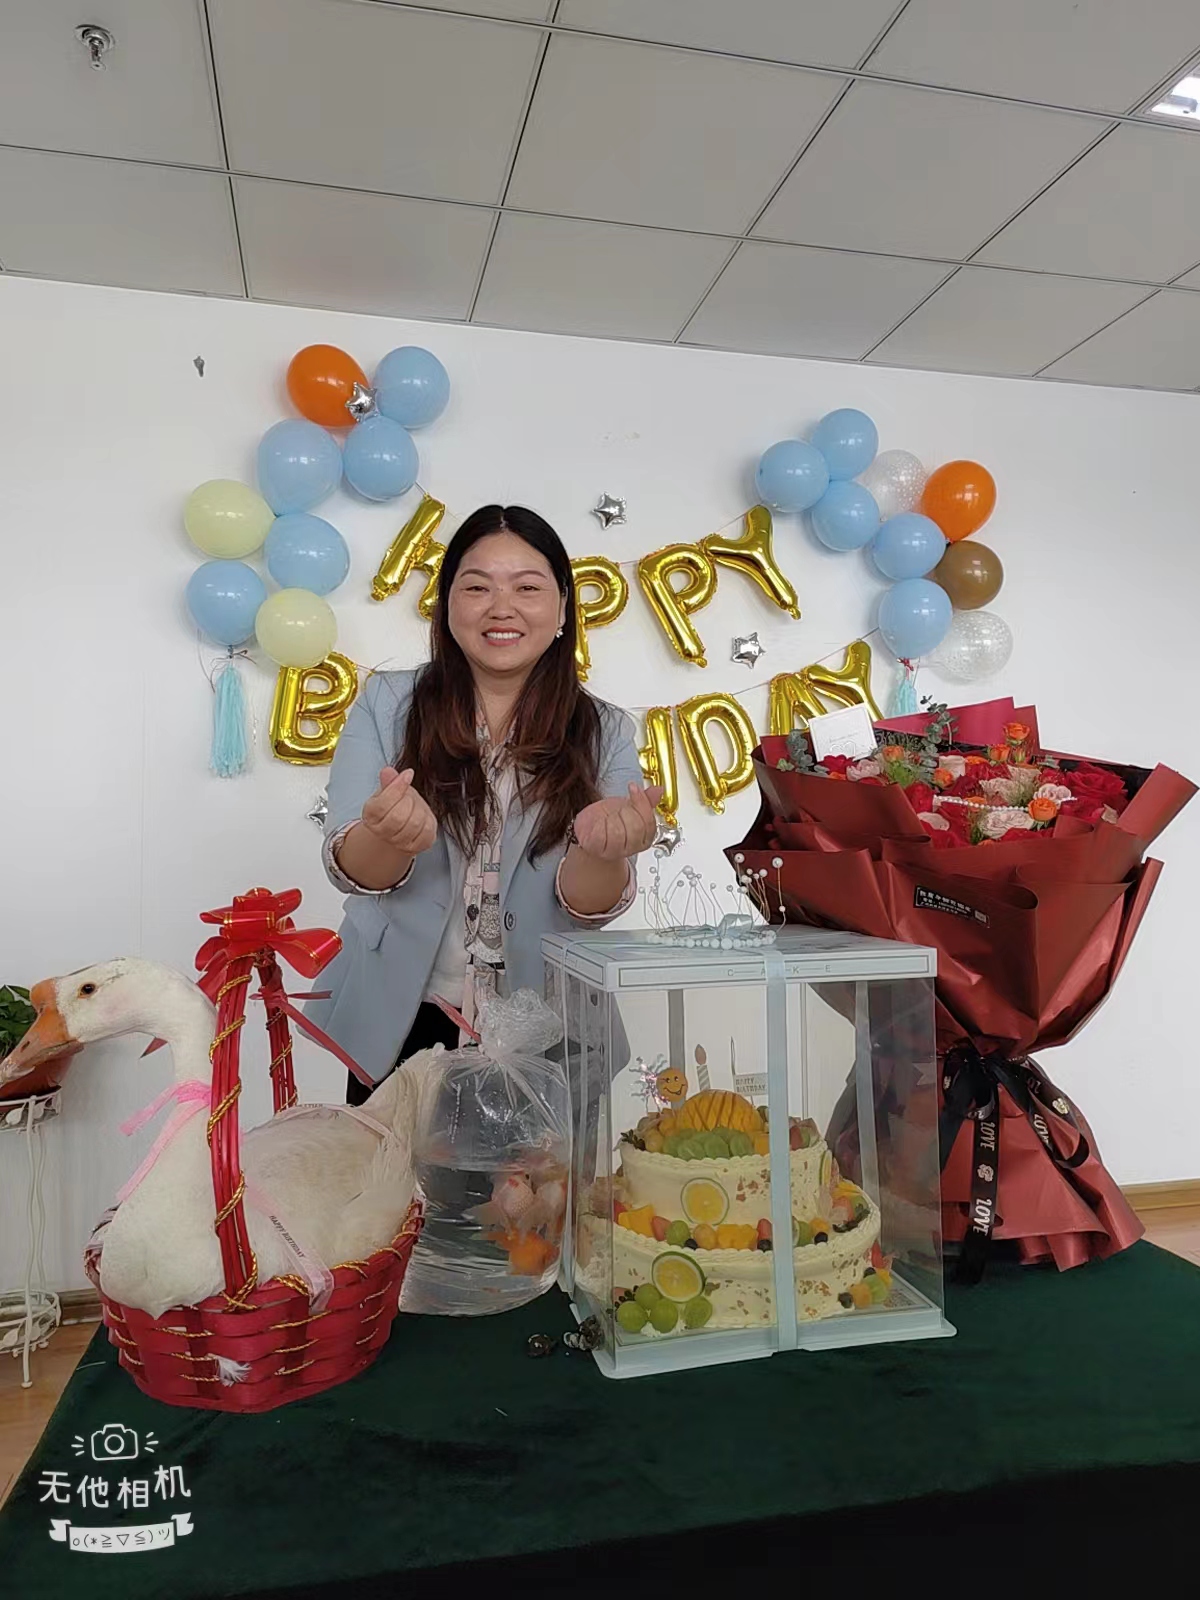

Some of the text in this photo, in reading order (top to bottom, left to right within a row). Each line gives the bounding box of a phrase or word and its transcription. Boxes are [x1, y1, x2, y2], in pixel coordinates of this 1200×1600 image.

[371, 494, 801, 679] HPPY
[980, 1121, 996, 1152] LOVE
[973, 1198, 993, 1237] LOVE
